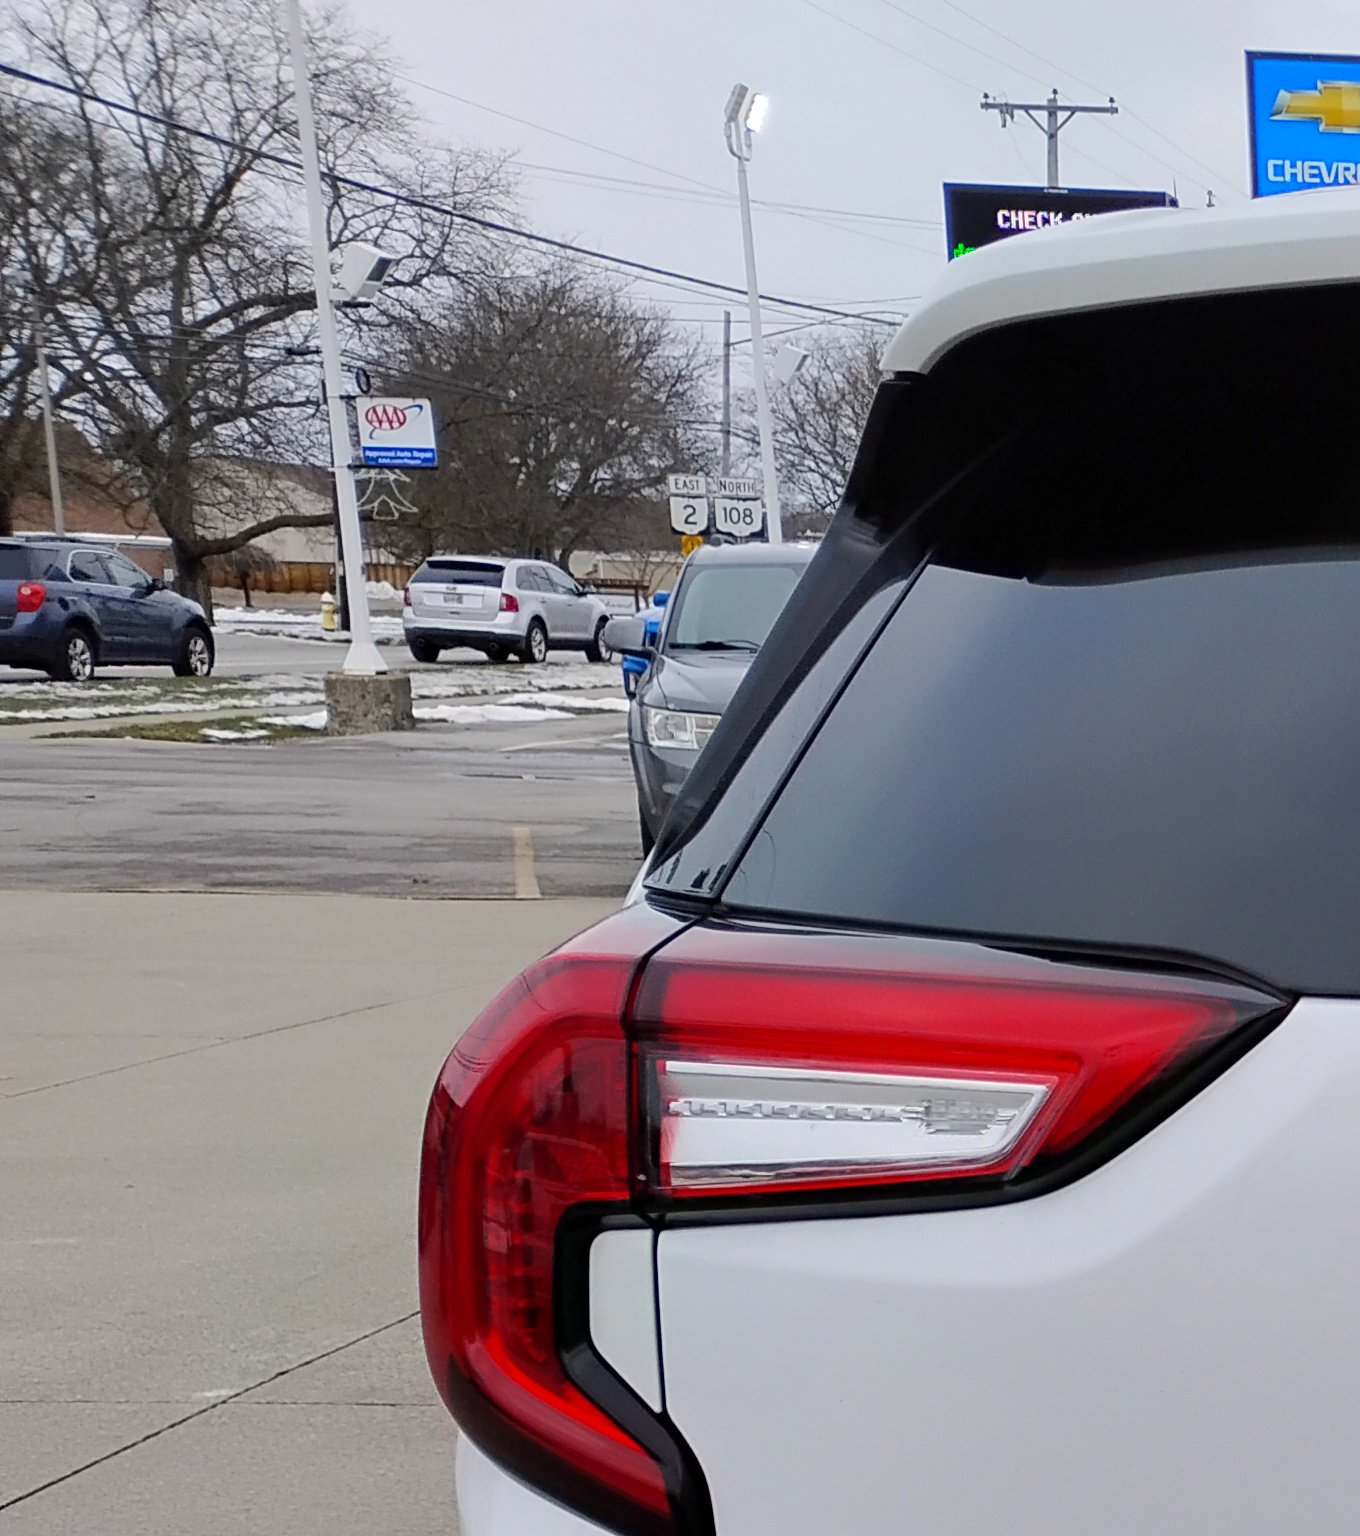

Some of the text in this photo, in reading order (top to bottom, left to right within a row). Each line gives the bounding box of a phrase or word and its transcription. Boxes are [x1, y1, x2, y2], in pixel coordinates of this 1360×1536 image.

[996, 209, 1063, 230] CHECK
[370, 404, 403, 430] AAA
[365, 450, 396, 458] Approved
[412, 451, 433, 459] Repair
[674, 478, 700, 491] EAST
[719, 479, 755, 493] NORTH
[683, 504, 698, 525] 2
[723, 506, 754, 525] 108
